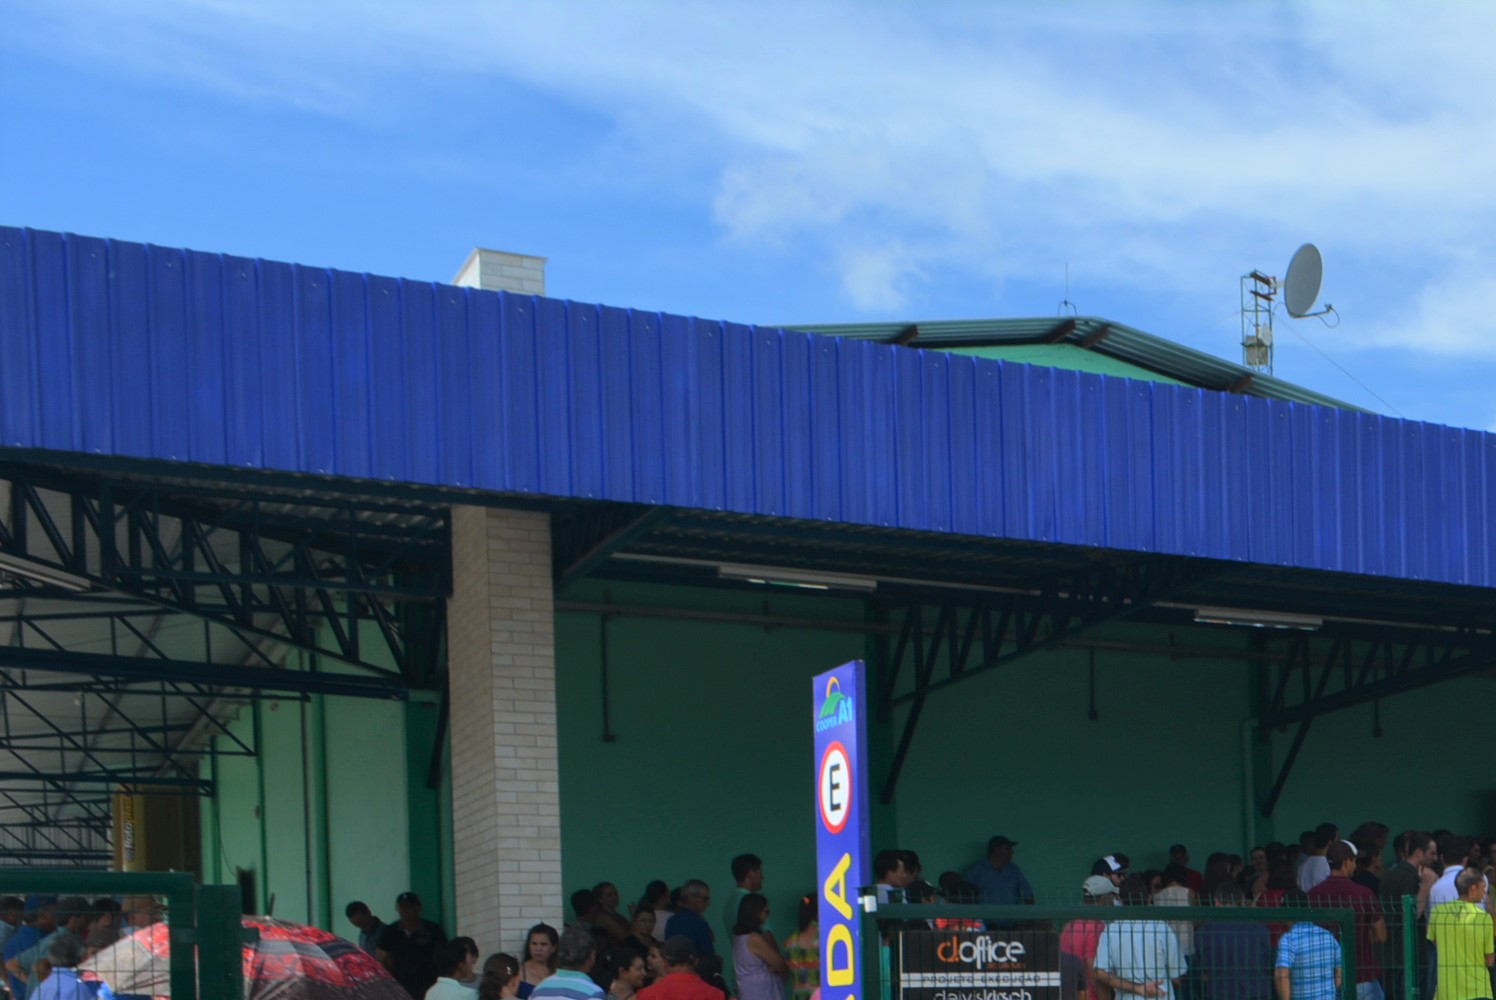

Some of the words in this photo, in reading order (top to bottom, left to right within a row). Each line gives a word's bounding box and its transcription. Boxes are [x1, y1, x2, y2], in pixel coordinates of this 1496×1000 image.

[816, 714, 838, 733] COOPER
[838, 697, 853, 725] A1
[830, 763, 841, 812] E
[923, 975, 974, 984] PROJETO
[981, 973, 1041, 984] EXECUÇÃO
